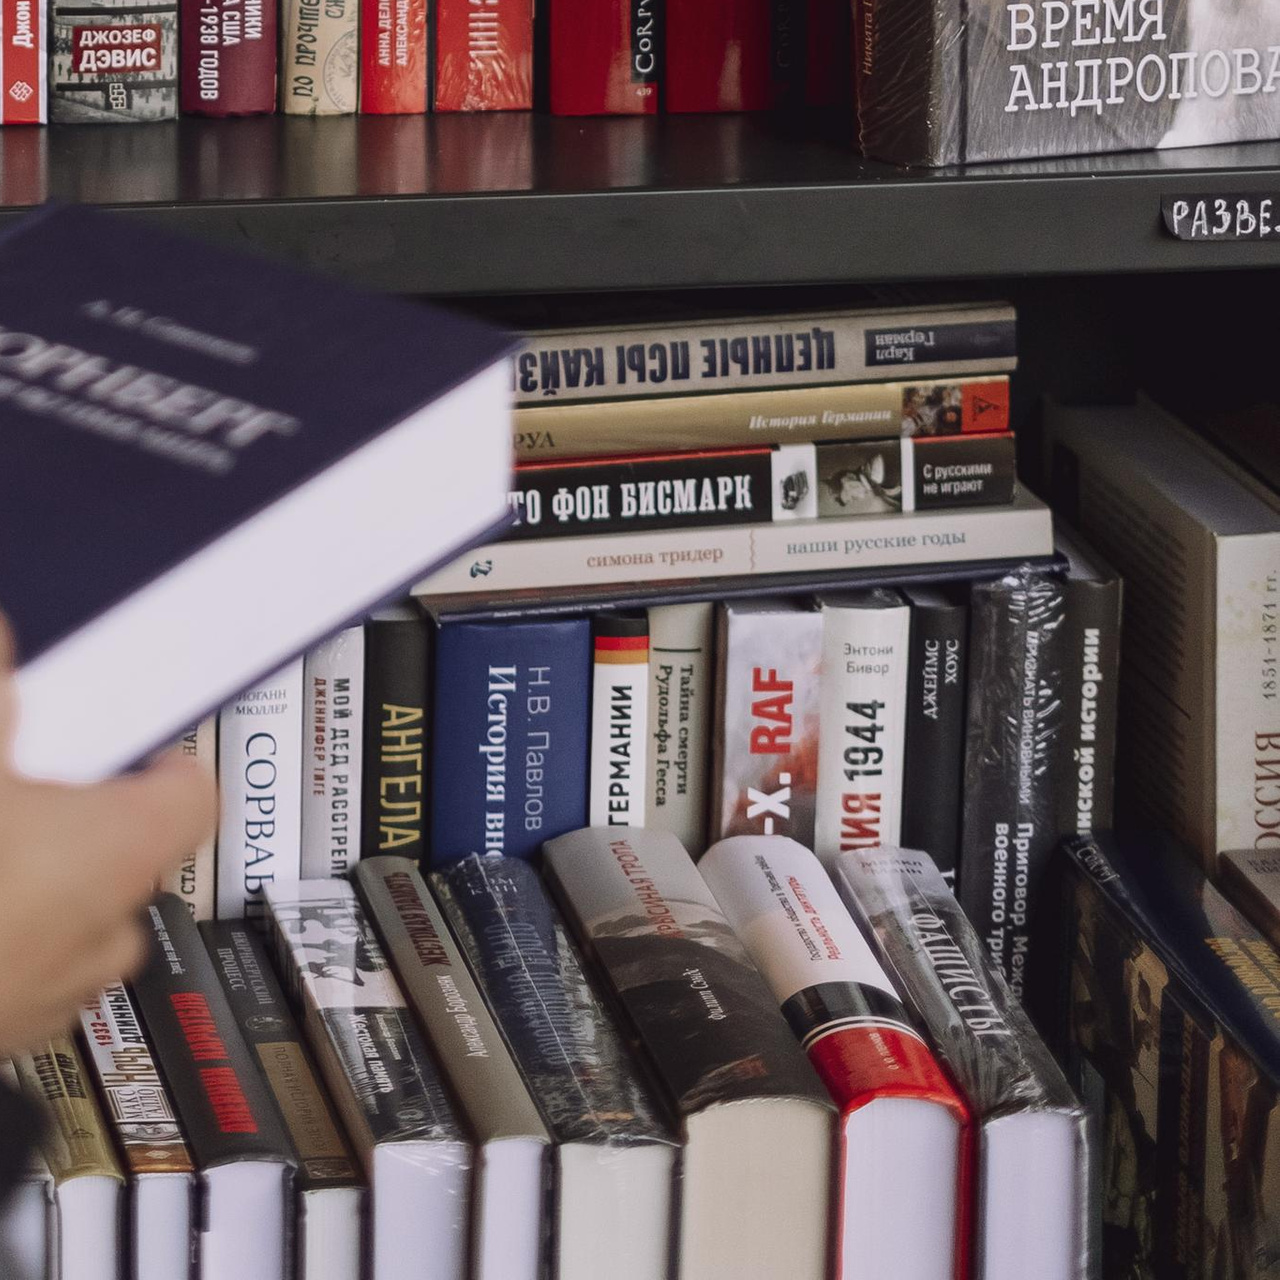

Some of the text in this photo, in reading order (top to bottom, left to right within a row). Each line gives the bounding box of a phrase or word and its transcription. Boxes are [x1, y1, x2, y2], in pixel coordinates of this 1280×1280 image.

[12, 0, 34, 49] Джон
[617, 327, 836, 382] ЦЕПНЫЕ ПСЫ
[552, 474, 752, 522] ФОН БИСМАРК
[586, 547, 724, 568] симона тридер
[786, 531, 967, 557] наши русские годы
[922, 640, 940, 719] ДЖЕЙМС
[944, 639, 959, 684] ХОУС
[1078, 628, 1101, 741] истории
[331, 678, 353, 767] МОЙ ДЕД
[479, 665, 517, 802] История
[654, 665, 673, 807] Рудольфа Гесса
[750, 667, 794, 755] RAF
[844, 699, 885, 783] 1944
[378, 704, 423, 850] АНГЕЛА
[608, 685, 632, 827] ГЕРМАНИИ
[907, 912, 1012, 1039] ФАШИСТЫ
